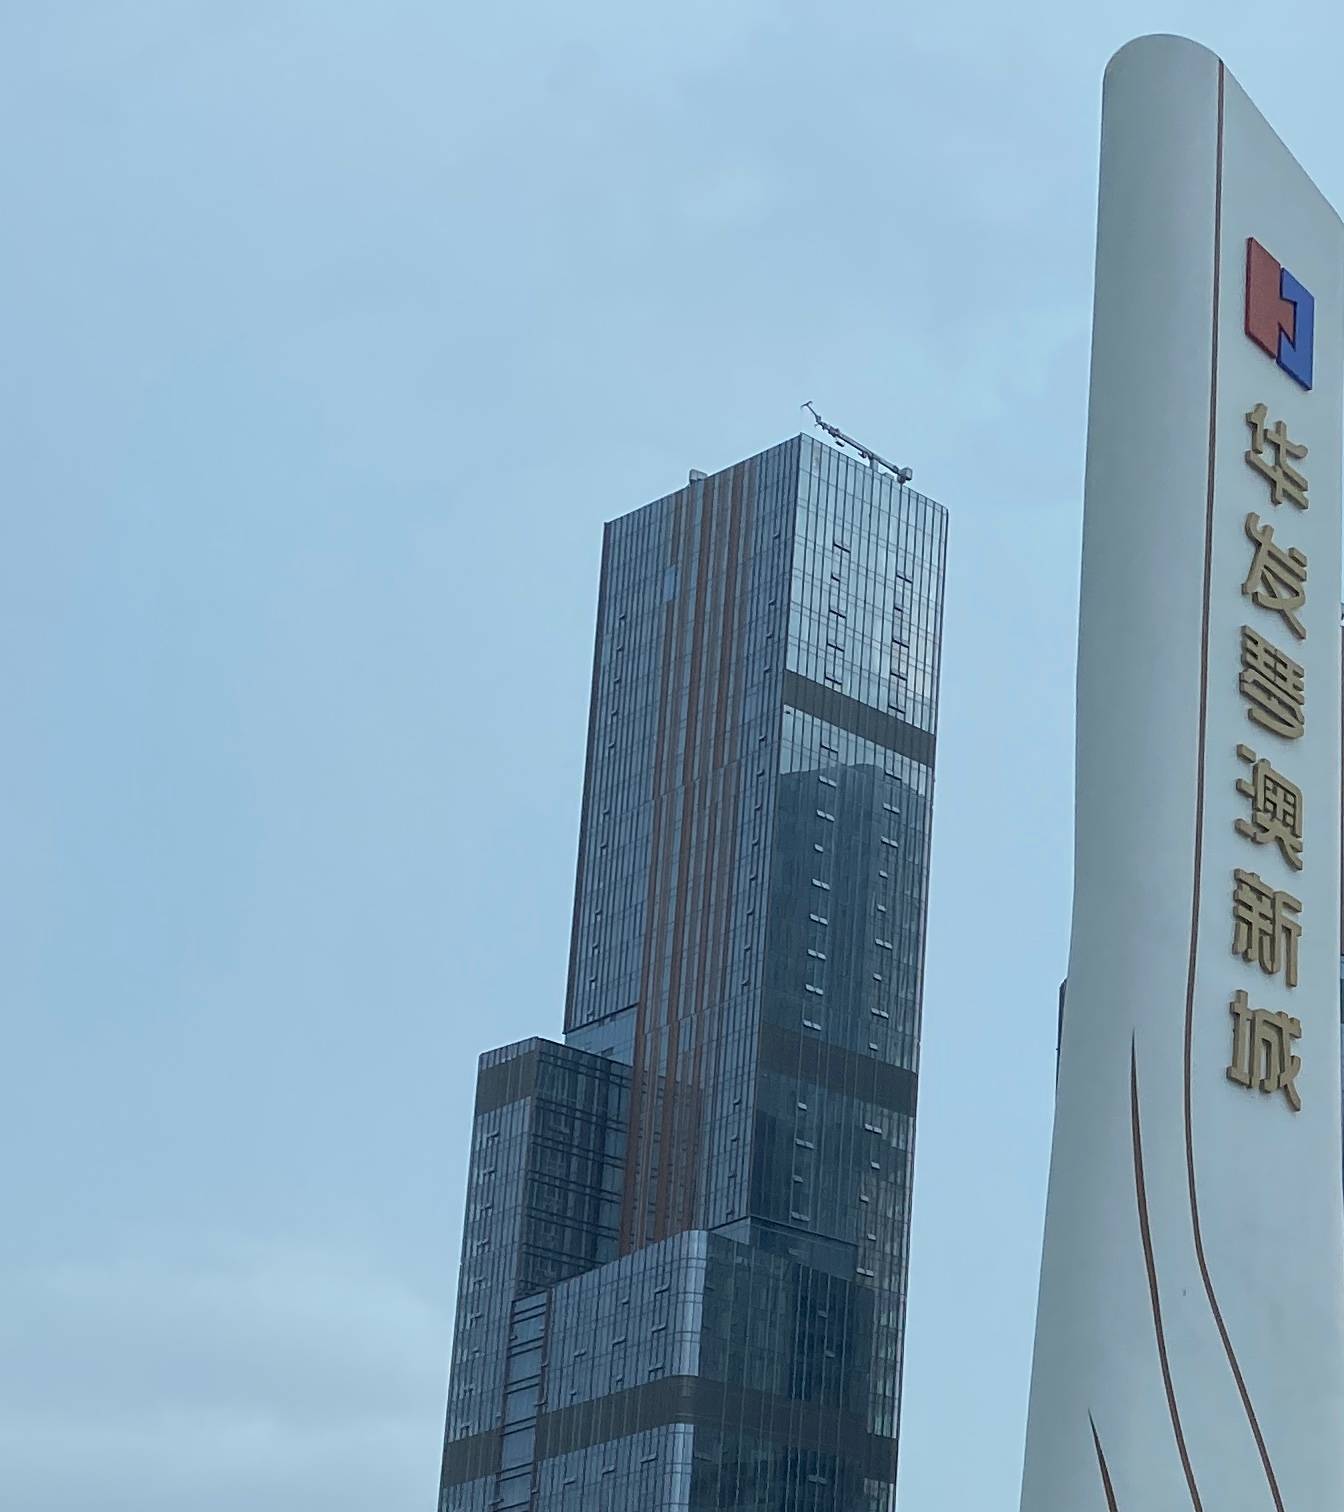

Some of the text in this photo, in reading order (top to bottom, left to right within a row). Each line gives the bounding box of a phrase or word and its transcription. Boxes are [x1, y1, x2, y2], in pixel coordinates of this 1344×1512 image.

[1226, 403, 1309, 1113] 华发琴澳新城
